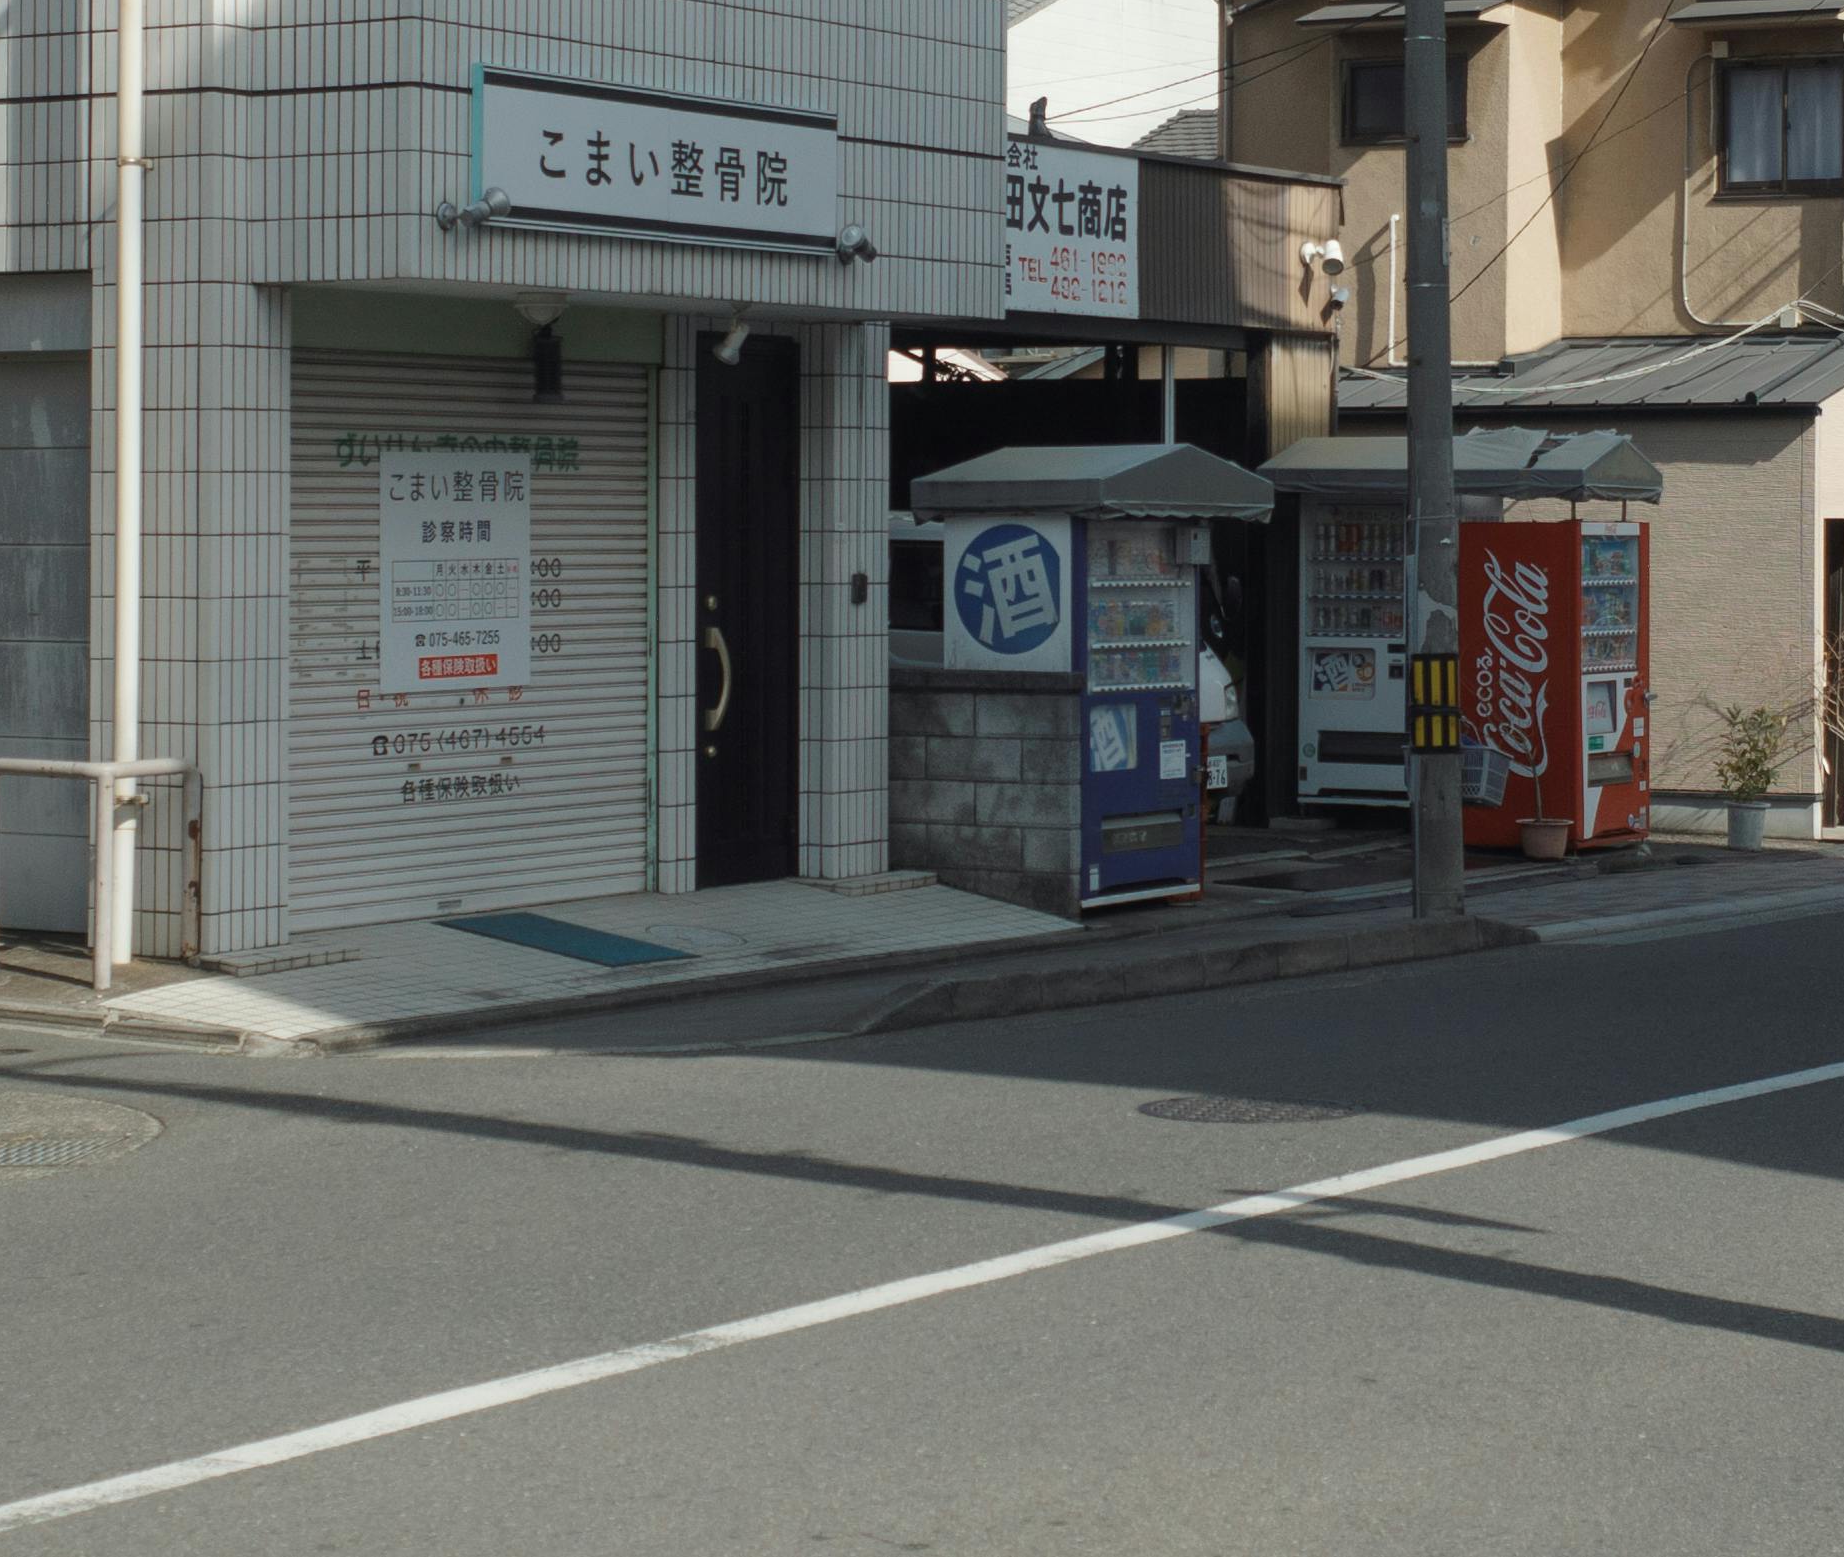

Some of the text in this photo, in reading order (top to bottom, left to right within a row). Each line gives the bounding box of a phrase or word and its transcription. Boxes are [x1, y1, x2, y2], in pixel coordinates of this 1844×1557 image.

[539, 129, 788, 207] こまい整骨院
[1018, 256, 1048, 283] TEL
[389, 470, 525, 502] こまい整骨院
[421, 519, 492, 544] 診察時間
[435, 563, 444, 577] 月
[485, 562, 493, 575] 金
[497, 563, 505, 575] 土
[962, 534, 1059, 645] 酒
[429, 629, 500, 647] 075-465-7255
[420, 657, 497, 677] 各種保険取扱い
[1483, 547, 1549, 778] Coca-Cola
[400, 774, 521, 804] 各種保険取扱い
